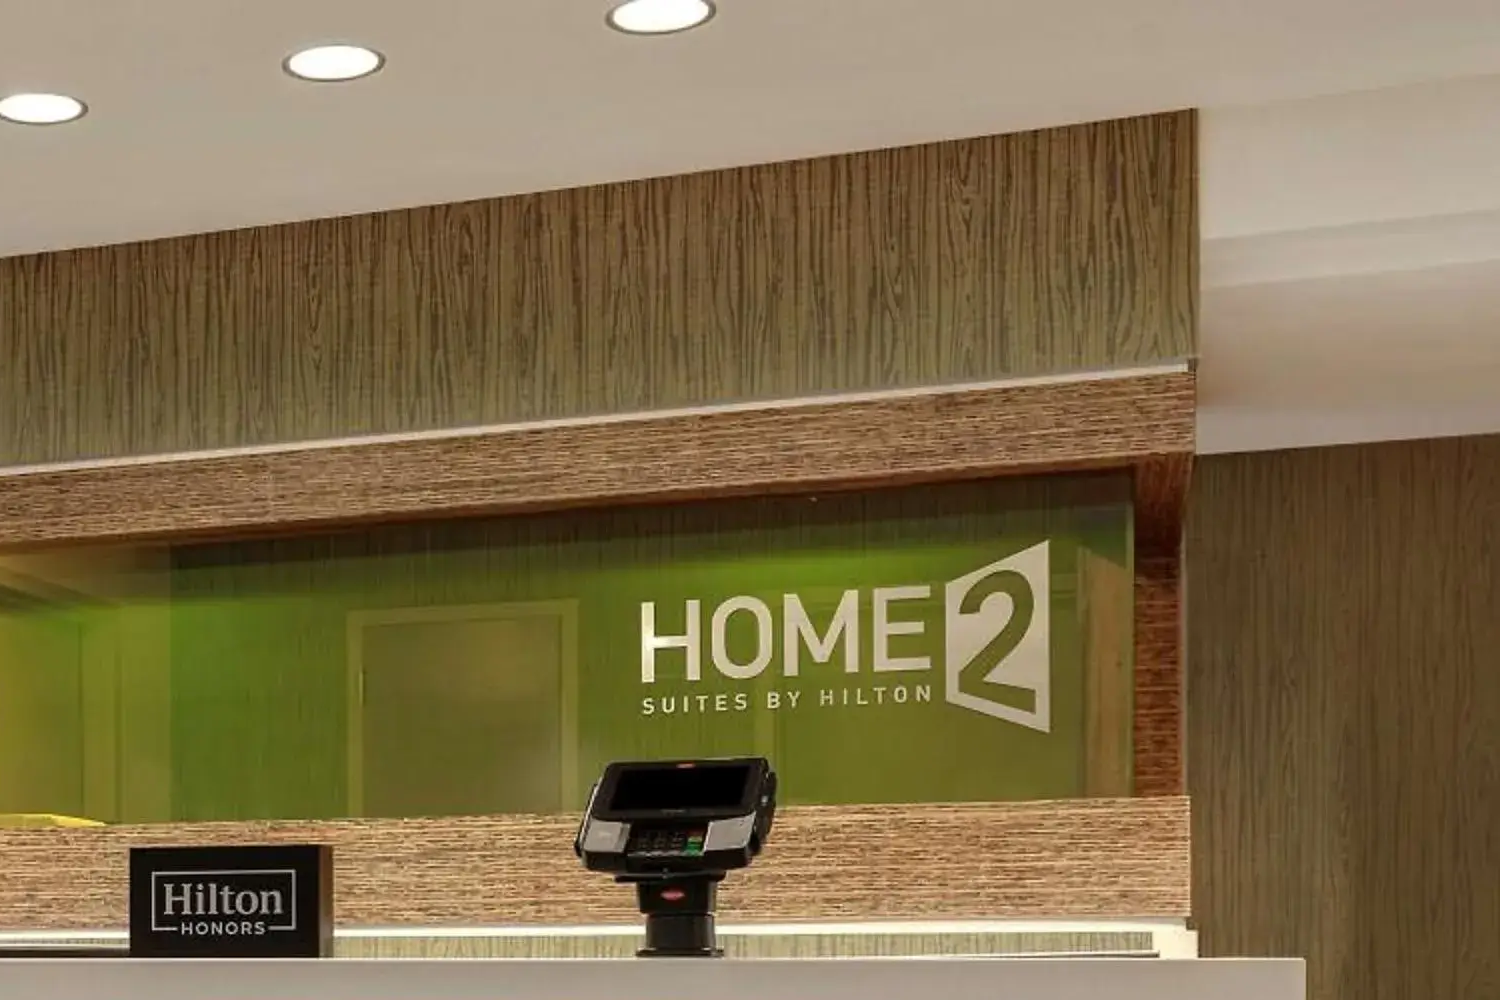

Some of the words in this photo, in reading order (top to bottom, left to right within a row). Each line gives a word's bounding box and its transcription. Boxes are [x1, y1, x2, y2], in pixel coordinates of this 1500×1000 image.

[641, 585, 931, 683] HOME
[958, 570, 1037, 715] 2
[642, 694, 749, 715] SUITES
[767, 691, 802, 709] BY
[819, 685, 932, 706] HILTON
[163, 883, 283, 915] Hilton
[181, 921, 266, 935] HONORS
